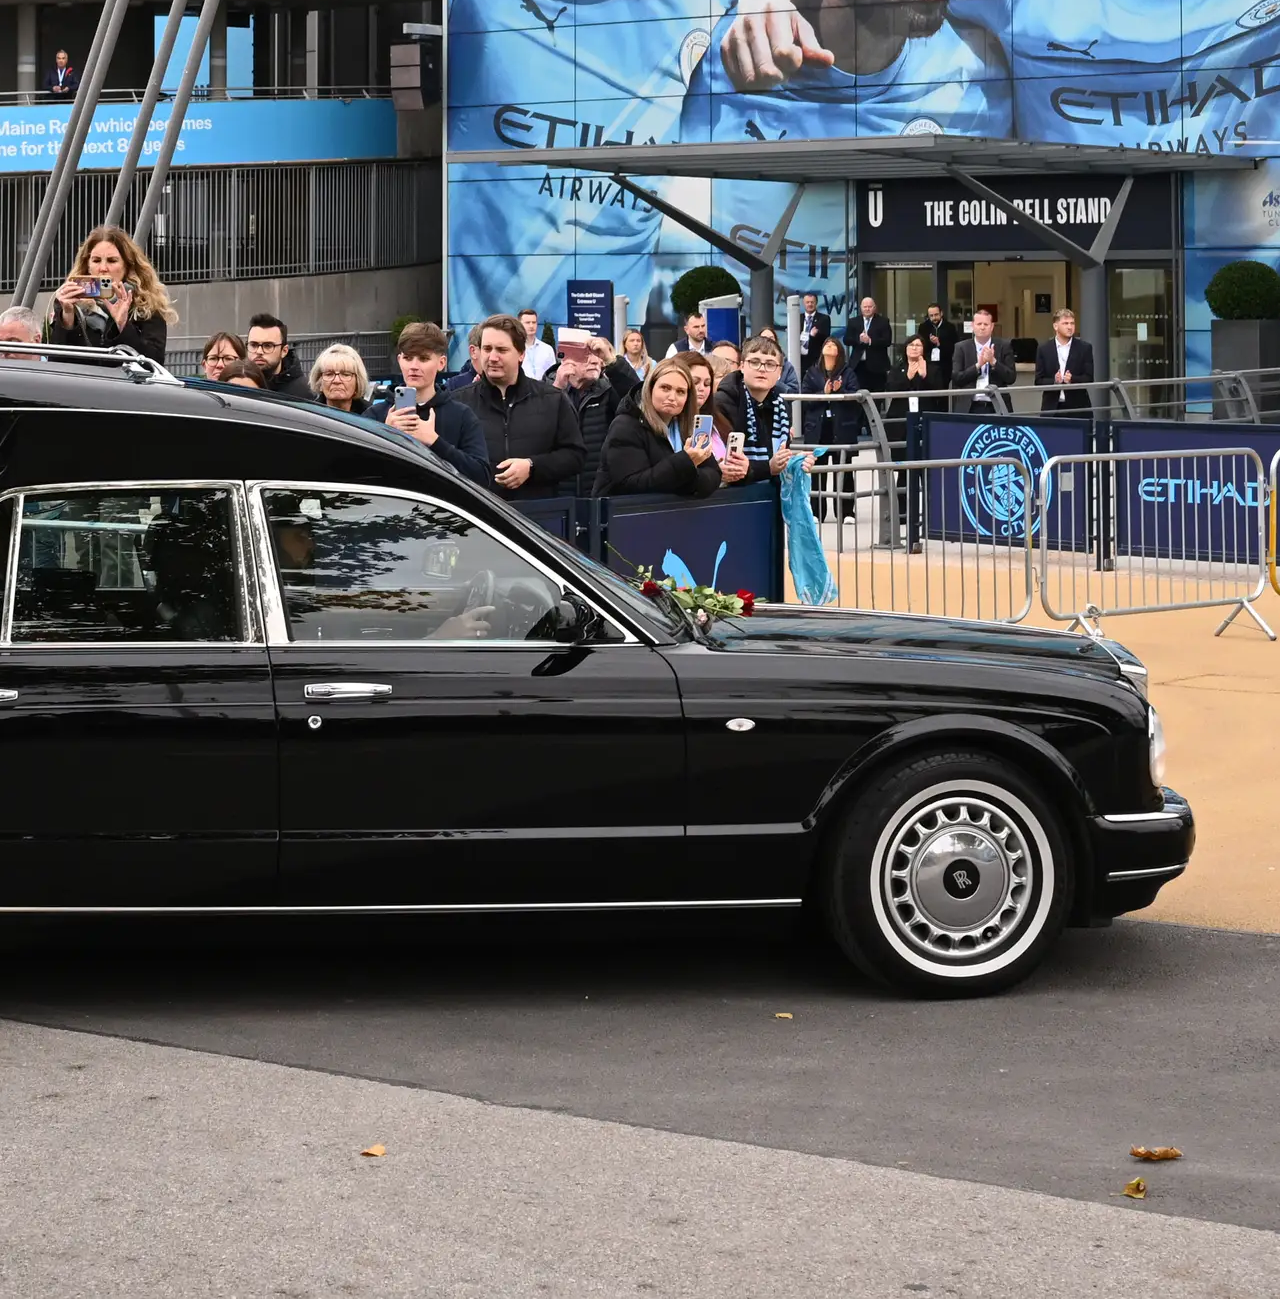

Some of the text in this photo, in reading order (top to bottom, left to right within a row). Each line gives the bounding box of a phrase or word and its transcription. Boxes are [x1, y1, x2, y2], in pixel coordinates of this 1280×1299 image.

[20, 139, 43, 156] for
[868, 190, 884, 228] U
[924, 201, 954, 227] THE
[1056, 197, 1112, 225] STAND
[1138, 477, 1271, 508] ETIHAD
